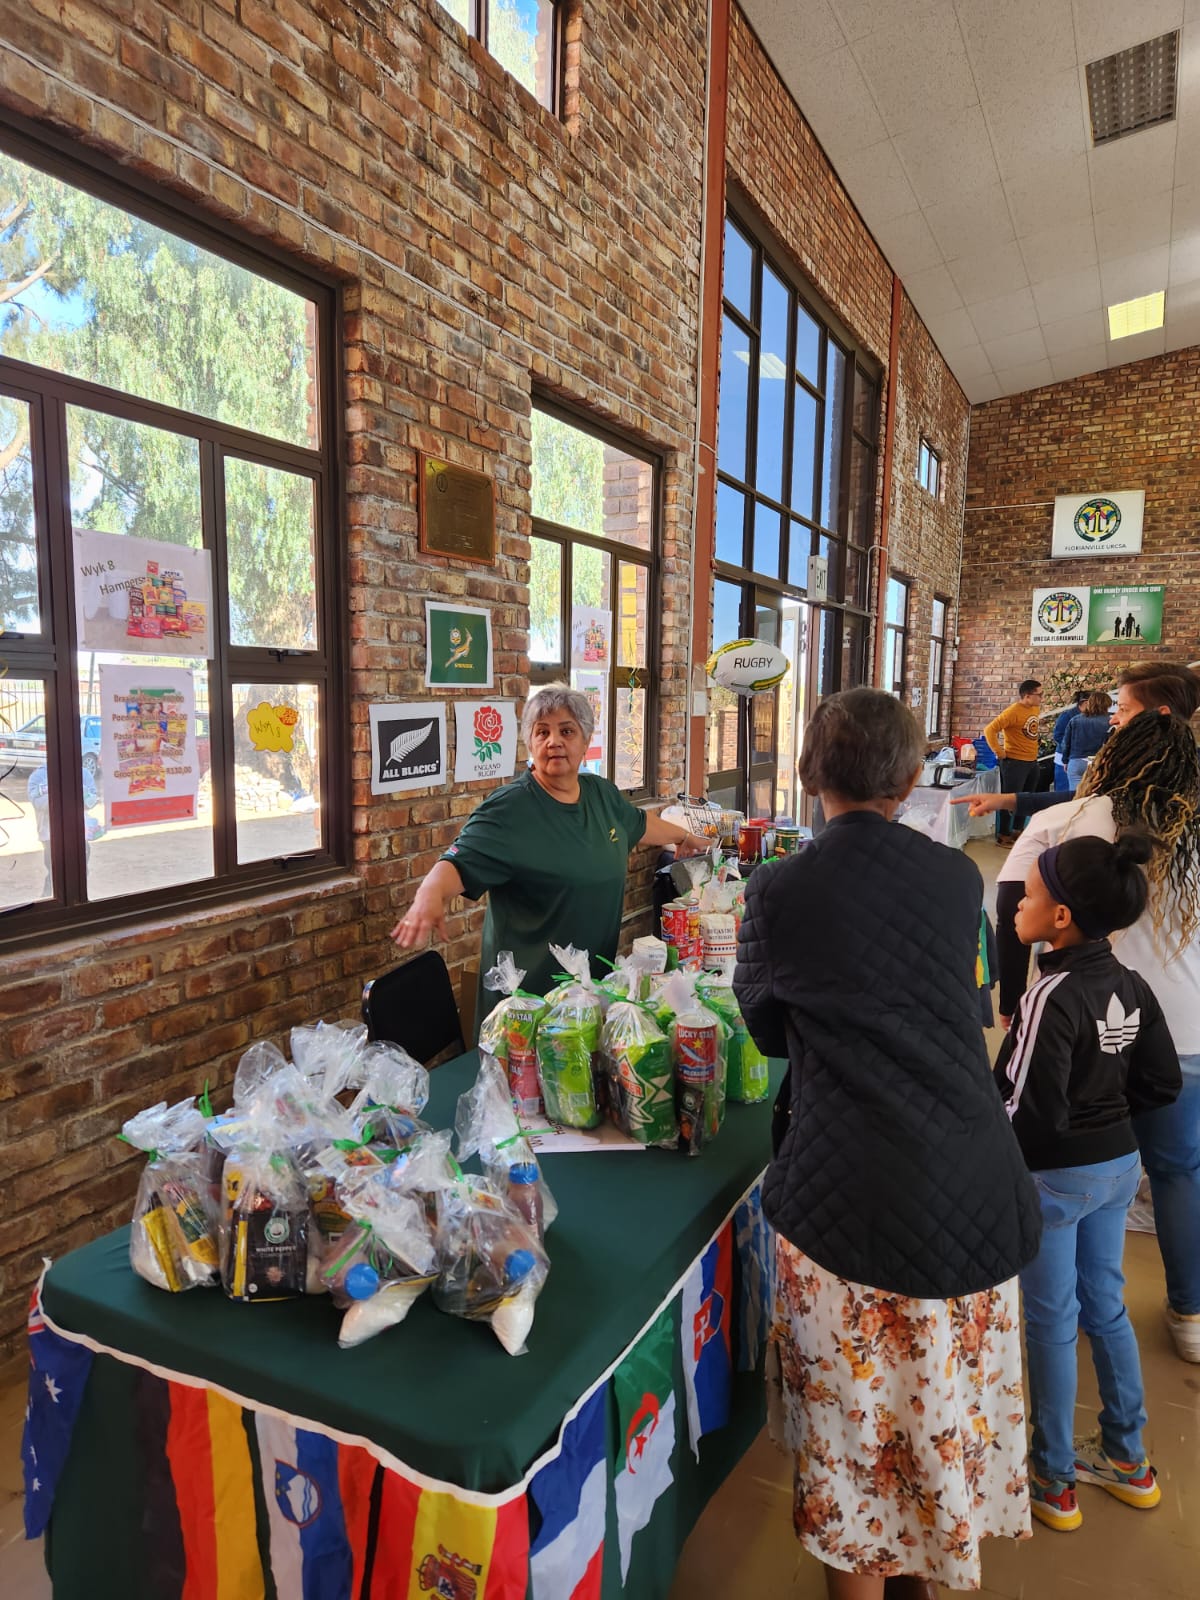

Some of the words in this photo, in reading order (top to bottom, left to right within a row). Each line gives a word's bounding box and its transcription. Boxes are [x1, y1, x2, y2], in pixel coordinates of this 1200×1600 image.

[80, 563, 106, 577] Wyk
[107, 560, 115, 571] 8
[733, 657, 774, 669] RUGBY
[382, 768, 400, 779] ALL
[401, 763, 437, 777] BLACKS
[473, 763, 501, 771] ENGLAND
[477, 770, 497, 778] RUGBY
[678, 1029, 697, 1038] LUCKY
[699, 1031, 714, 1039] STAR
